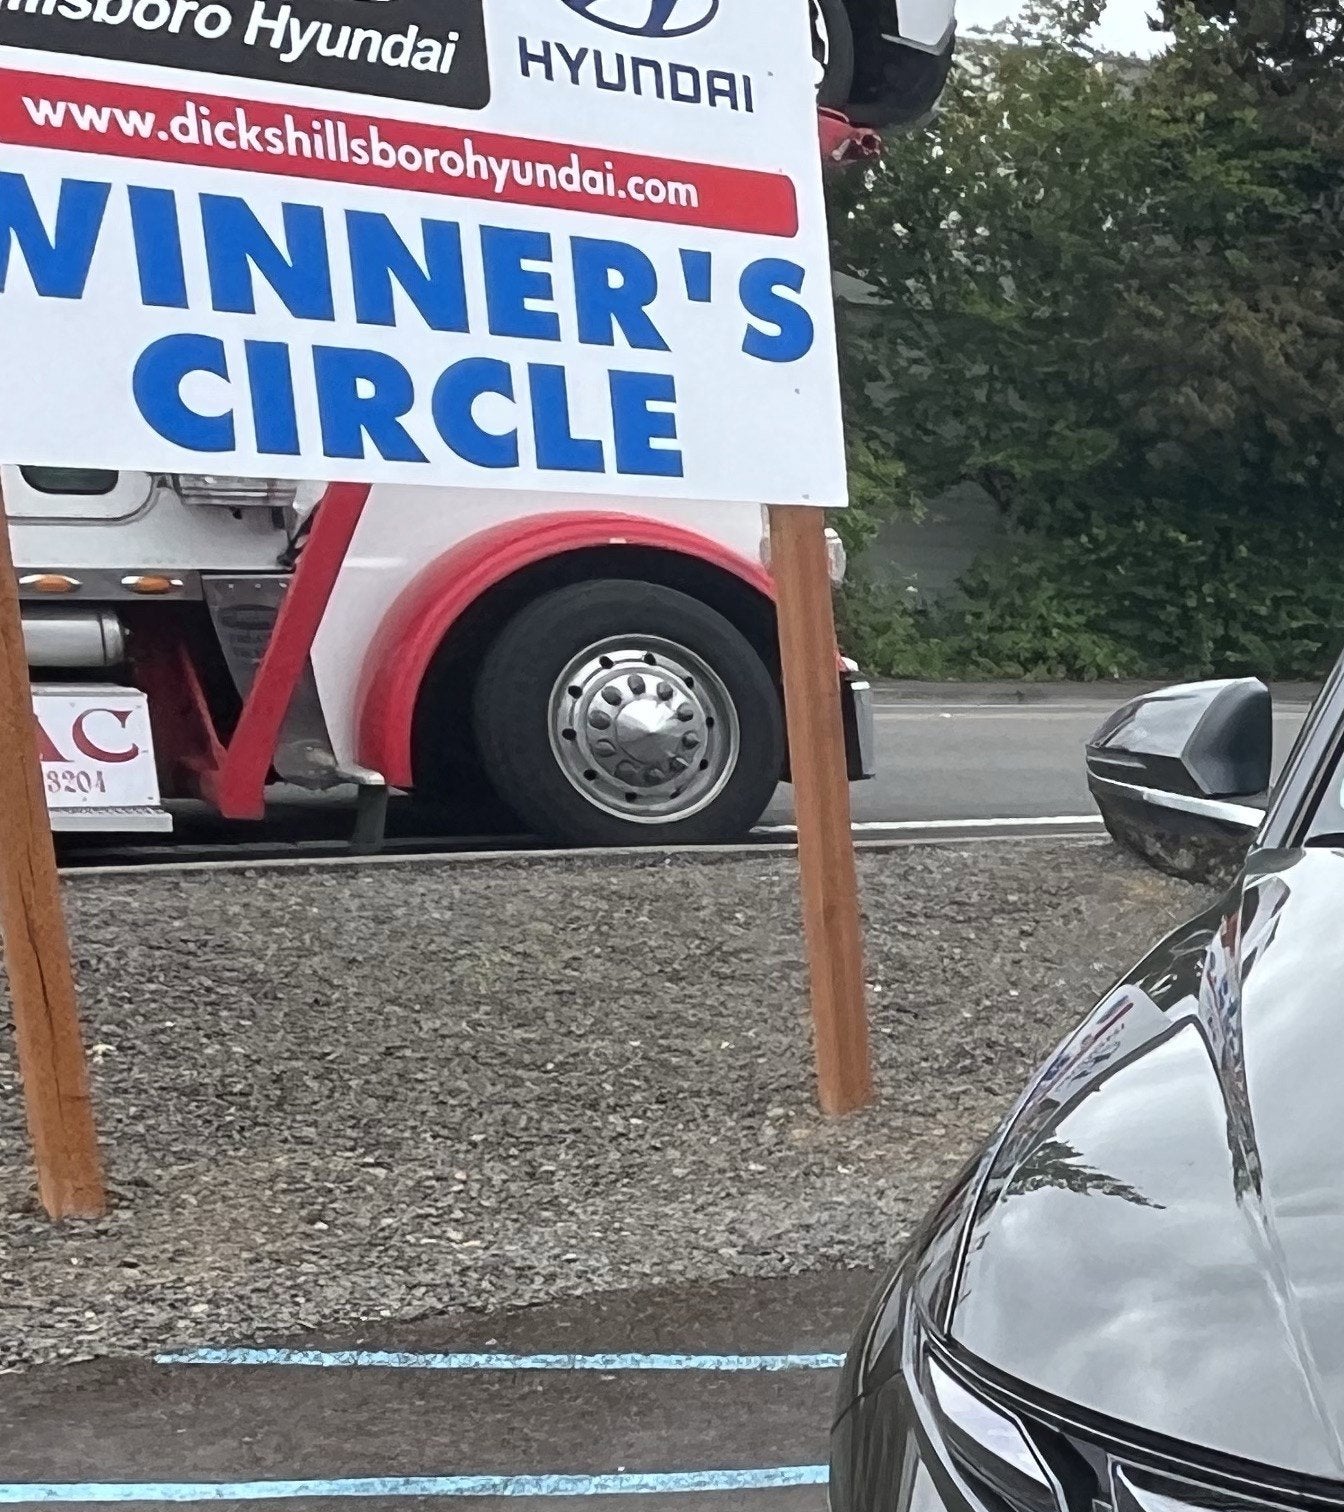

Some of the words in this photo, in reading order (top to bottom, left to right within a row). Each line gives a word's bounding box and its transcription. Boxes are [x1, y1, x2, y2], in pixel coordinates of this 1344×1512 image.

[244, 1, 459, 74] Hyundai
[518, 37, 754, 114] HYUNDAI
[23, 97, 700, 208] www.dickshillsborohyundai.com
[0, 171, 814, 363] WINNER'S
[132, 334, 684, 478] CIRCLE
